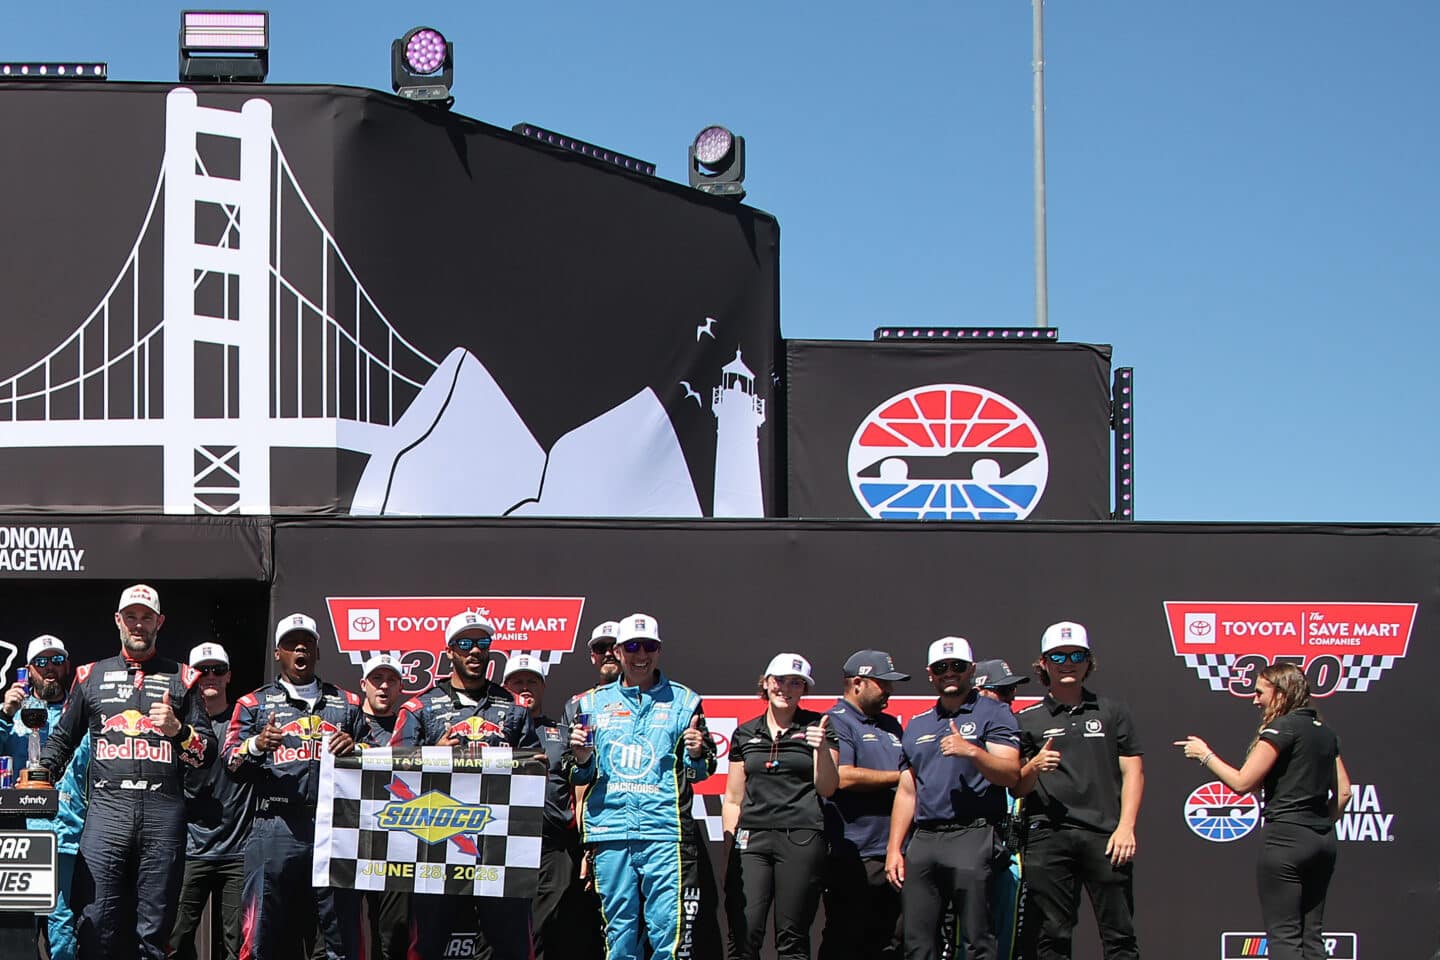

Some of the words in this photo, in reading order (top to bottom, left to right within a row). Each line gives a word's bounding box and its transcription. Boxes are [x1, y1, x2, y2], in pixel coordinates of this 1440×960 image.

[476, 607, 490, 616] The
[1309, 612, 1324, 621] The
[386, 617, 450, 632] TOYOT
[489, 617, 516, 632] AVE
[520, 617, 567, 632] MART
[1222, 621, 1296, 636] TOYOTA
[1309, 622, 1349, 636] SAVE
[1353, 623, 1400, 637] MART
[491, 632, 528, 641] MPANIES
[1309, 637, 1361, 646] COMPANIES
[858, 665, 872, 676] 97
[1228, 654, 1344, 697] 30
[975, 675, 987, 687] 97
[96, 737, 133, 761] Red
[133, 740, 172, 764] Bull
[273, 744, 308, 765] Red
[454, 758, 492, 768] MART
[607, 782, 660, 794] TRACKHOUSE
[19, 795, 47, 806] xfinity
[383, 807, 487, 828] SUNOCO
[361, 863, 415, 878] JUNE
[420, 865, 448, 880] 28,
[454, 866, 499, 881] 2026
